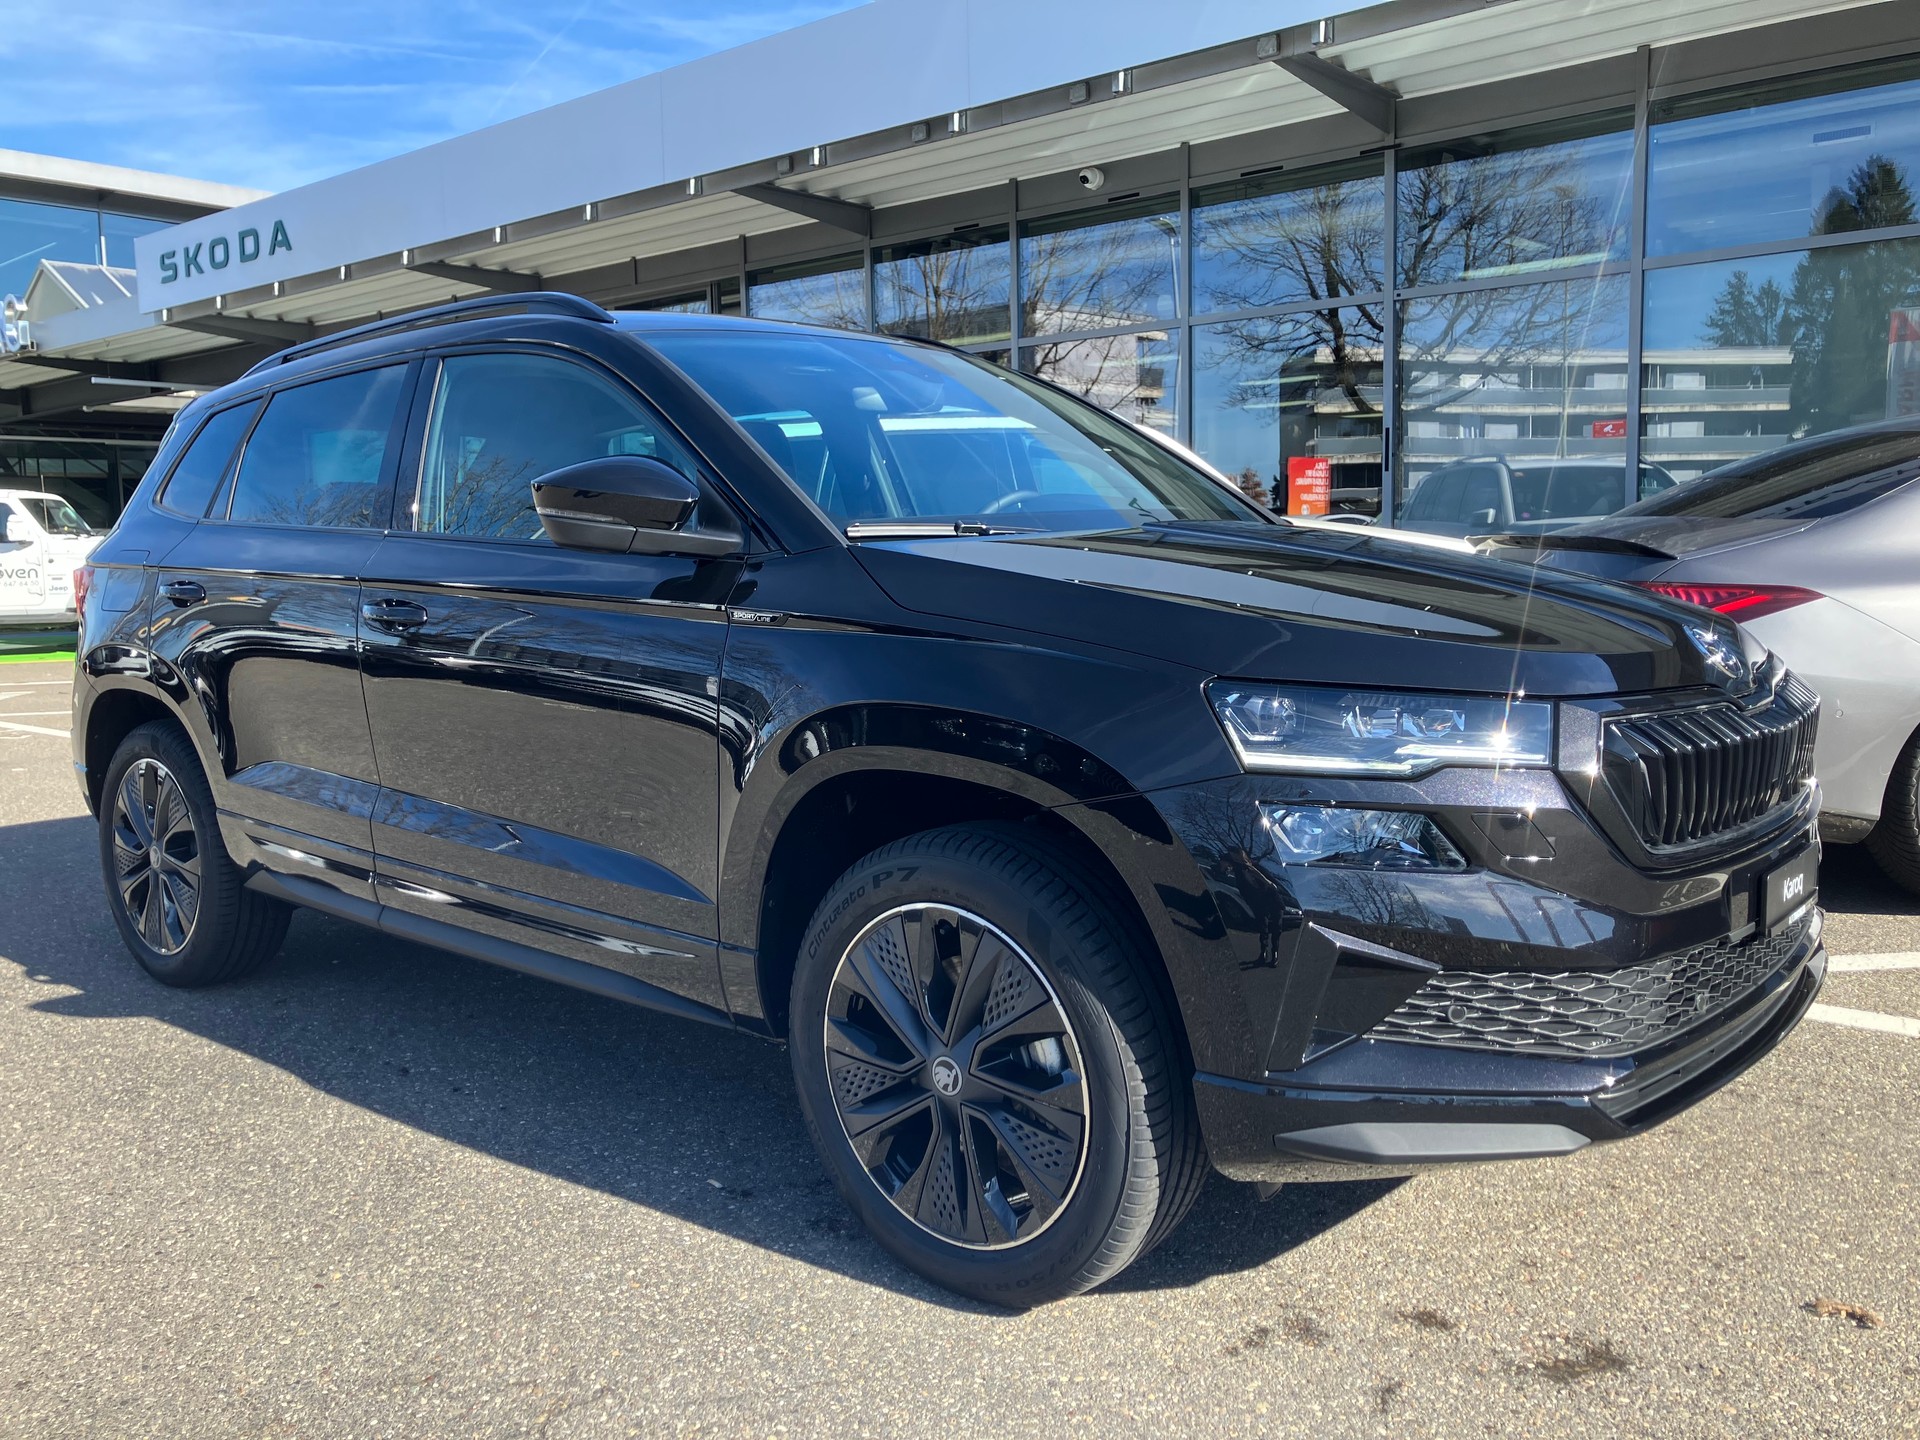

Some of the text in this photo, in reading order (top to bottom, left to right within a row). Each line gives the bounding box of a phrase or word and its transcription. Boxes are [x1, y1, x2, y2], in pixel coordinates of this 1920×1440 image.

[808, 866, 922, 961] Cinturato P7
[1783, 873, 1804, 902] Karoq
